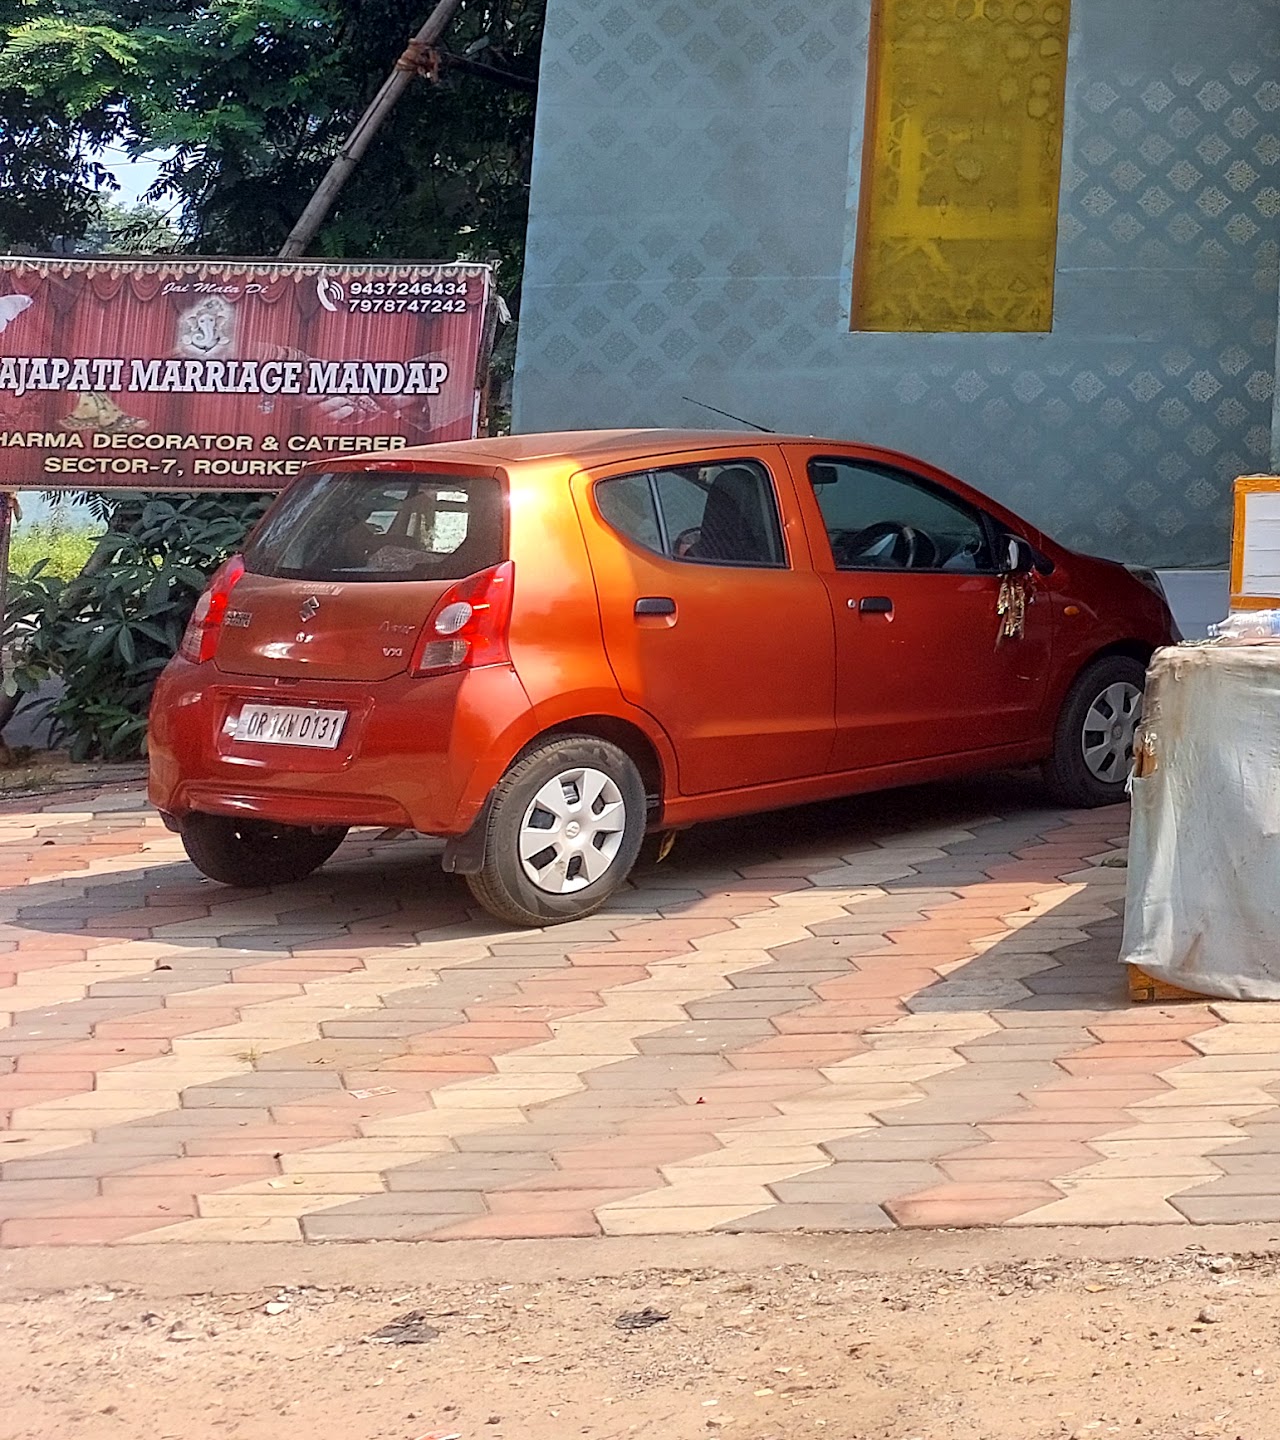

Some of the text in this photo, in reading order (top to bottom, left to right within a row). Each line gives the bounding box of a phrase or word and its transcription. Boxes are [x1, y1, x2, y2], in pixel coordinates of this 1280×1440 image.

[193, 282, 240, 294] Mata
[245, 283, 269, 294] Di
[350, 282, 467, 296] 9437246434
[349, 299, 467, 313] 7978747242
[129, 359, 302, 394] MARRIAGE
[307, 361, 448, 395] MANDAP
[93, 433, 253, 451] DECORATOR
[261, 435, 280, 451] &
[44, 457, 307, 476] SECTOR-7, ROURKE
[247, 711, 268, 736] OR
[299, 715, 340, 741] 0131
